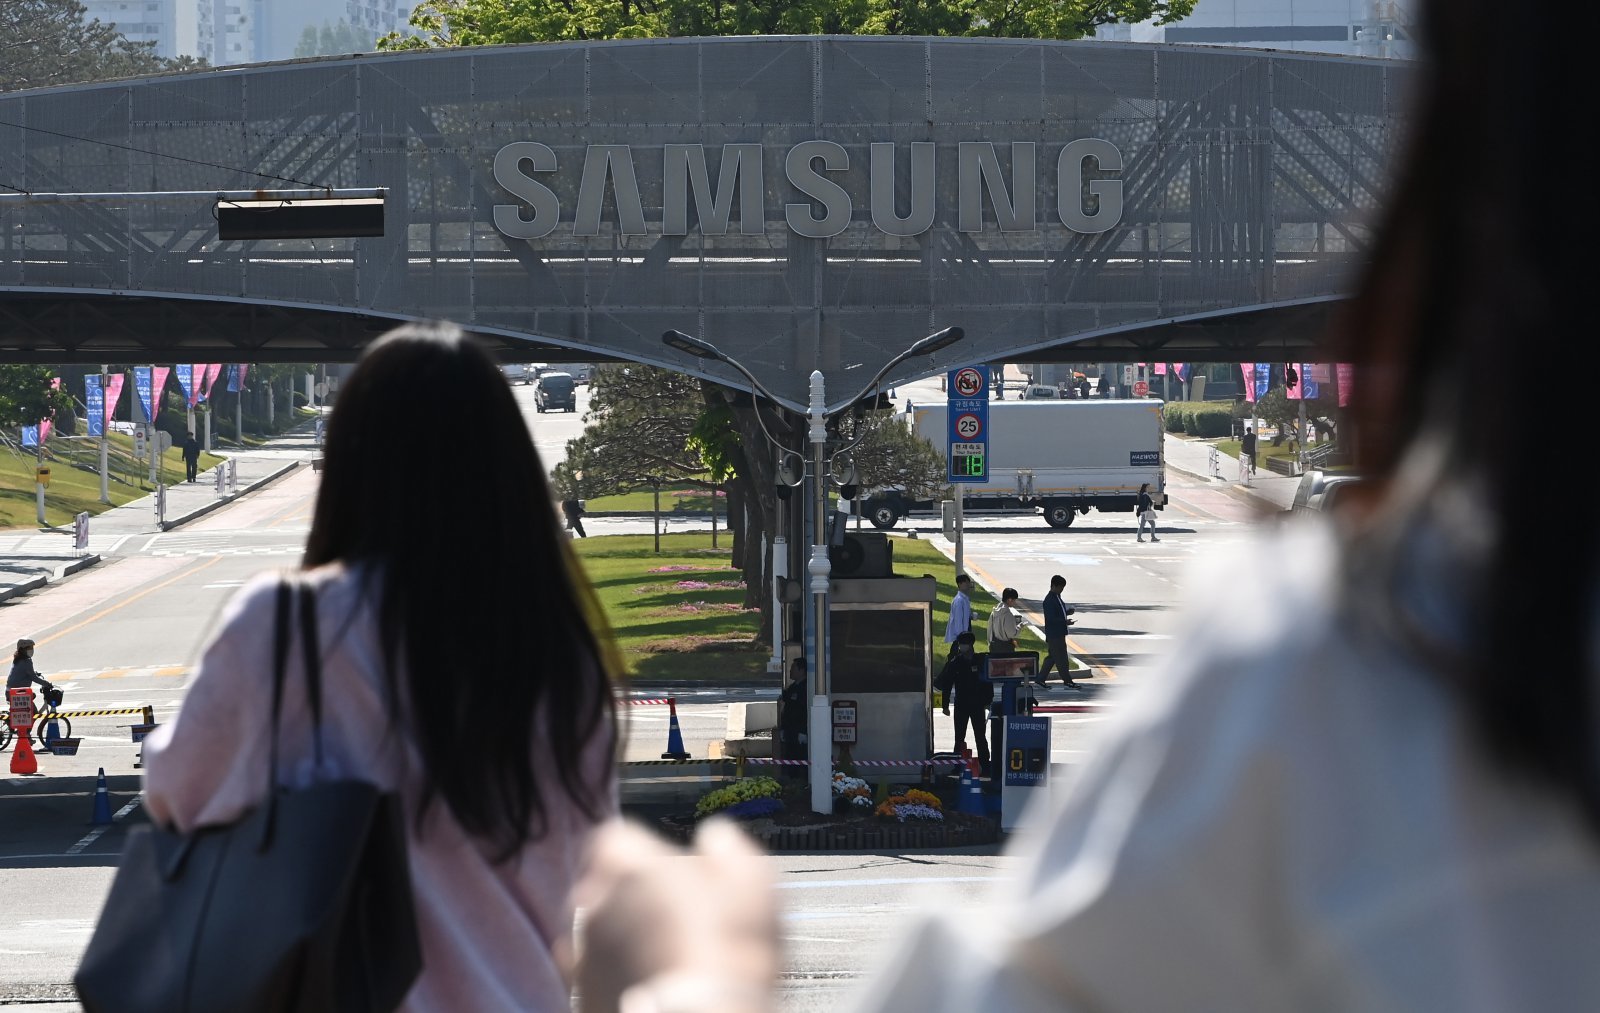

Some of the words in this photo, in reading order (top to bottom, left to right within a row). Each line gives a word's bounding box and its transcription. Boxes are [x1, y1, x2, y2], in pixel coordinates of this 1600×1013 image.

[493, 138, 1124, 239] SAMSUNG
[961, 421, 976, 432] 25
[967, 455, 982, 476] 18
[1011, 749, 1023, 770] 0
